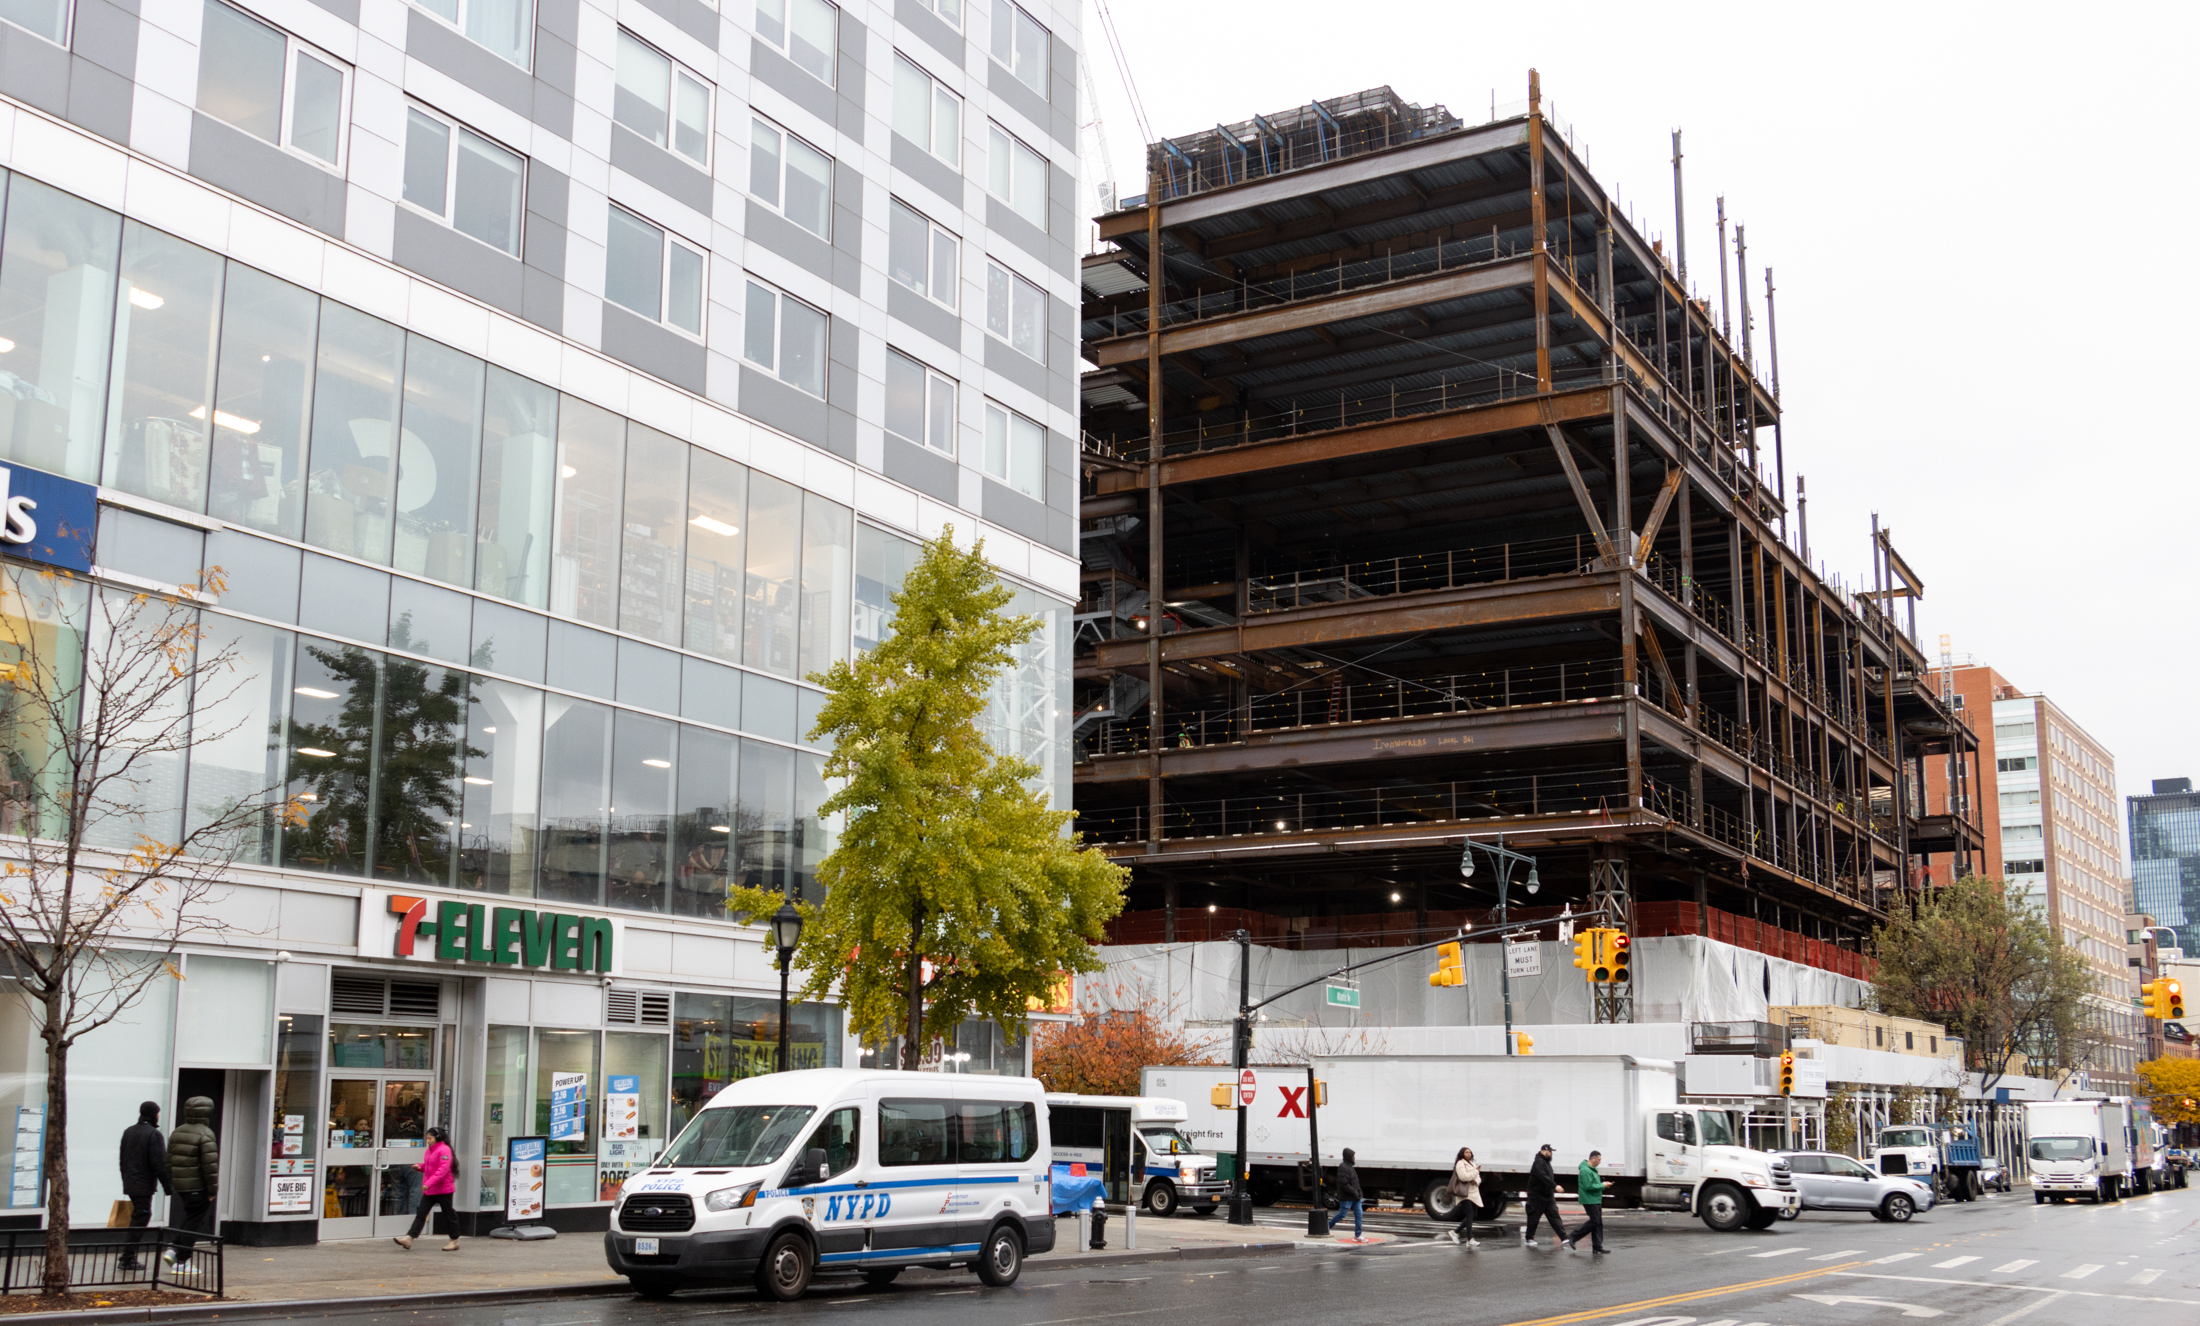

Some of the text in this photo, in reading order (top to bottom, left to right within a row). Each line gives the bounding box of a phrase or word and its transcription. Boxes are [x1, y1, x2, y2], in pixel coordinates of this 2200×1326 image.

[1523, 945, 1538, 953] LANE
[1515, 955, 1533, 964] MUST
[1526, 965, 1539, 973] LEFT
[555, 1075, 584, 1088] POWER UP
[1276, 1086, 1310, 1119] X
[1207, 1130, 1223, 1139] first
[612, 1161, 624, 1169] WITH
[277, 1181, 307, 1193] SAVE BIG
[640, 1183, 685, 1191] POLICE
[765, 1188, 790, 1198] POLICE
[823, 1193, 892, 1222] NYPD
